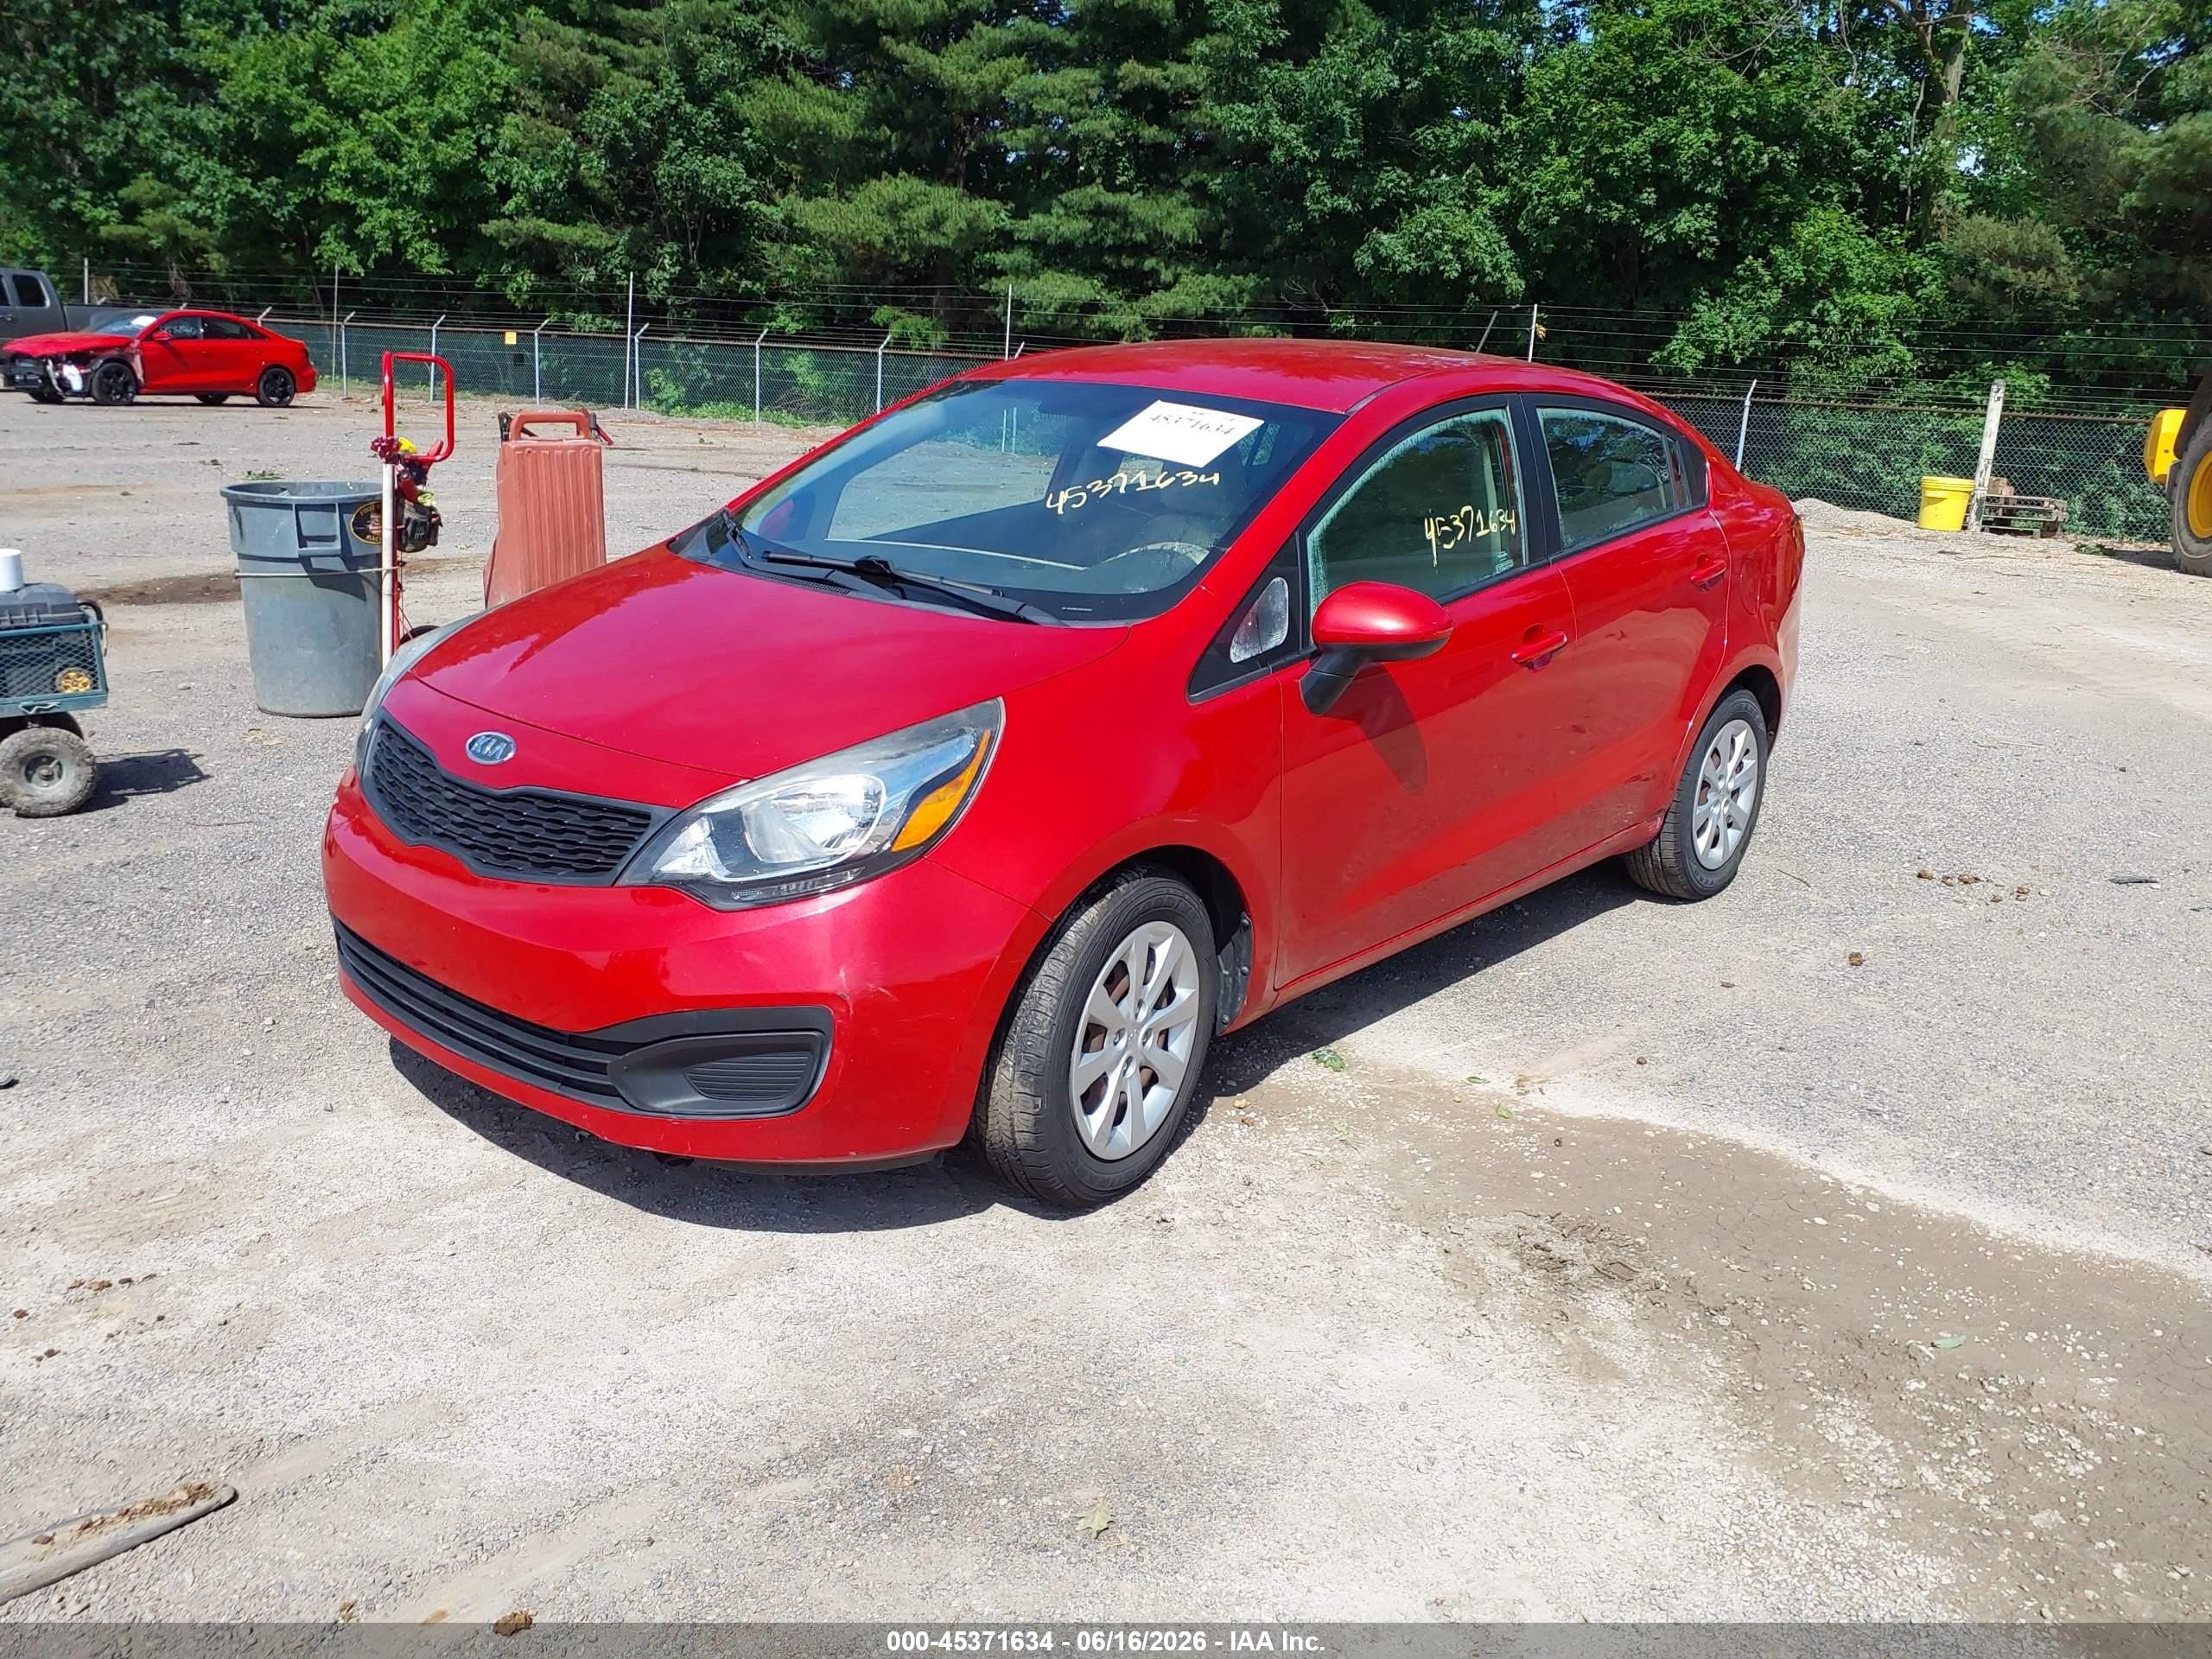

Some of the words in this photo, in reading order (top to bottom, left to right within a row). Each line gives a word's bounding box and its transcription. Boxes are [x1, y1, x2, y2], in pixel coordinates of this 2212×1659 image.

[1046, 468, 1221, 515] 45371634
[1425, 505, 1516, 568] 45371634
[471, 735, 507, 760] KIA
